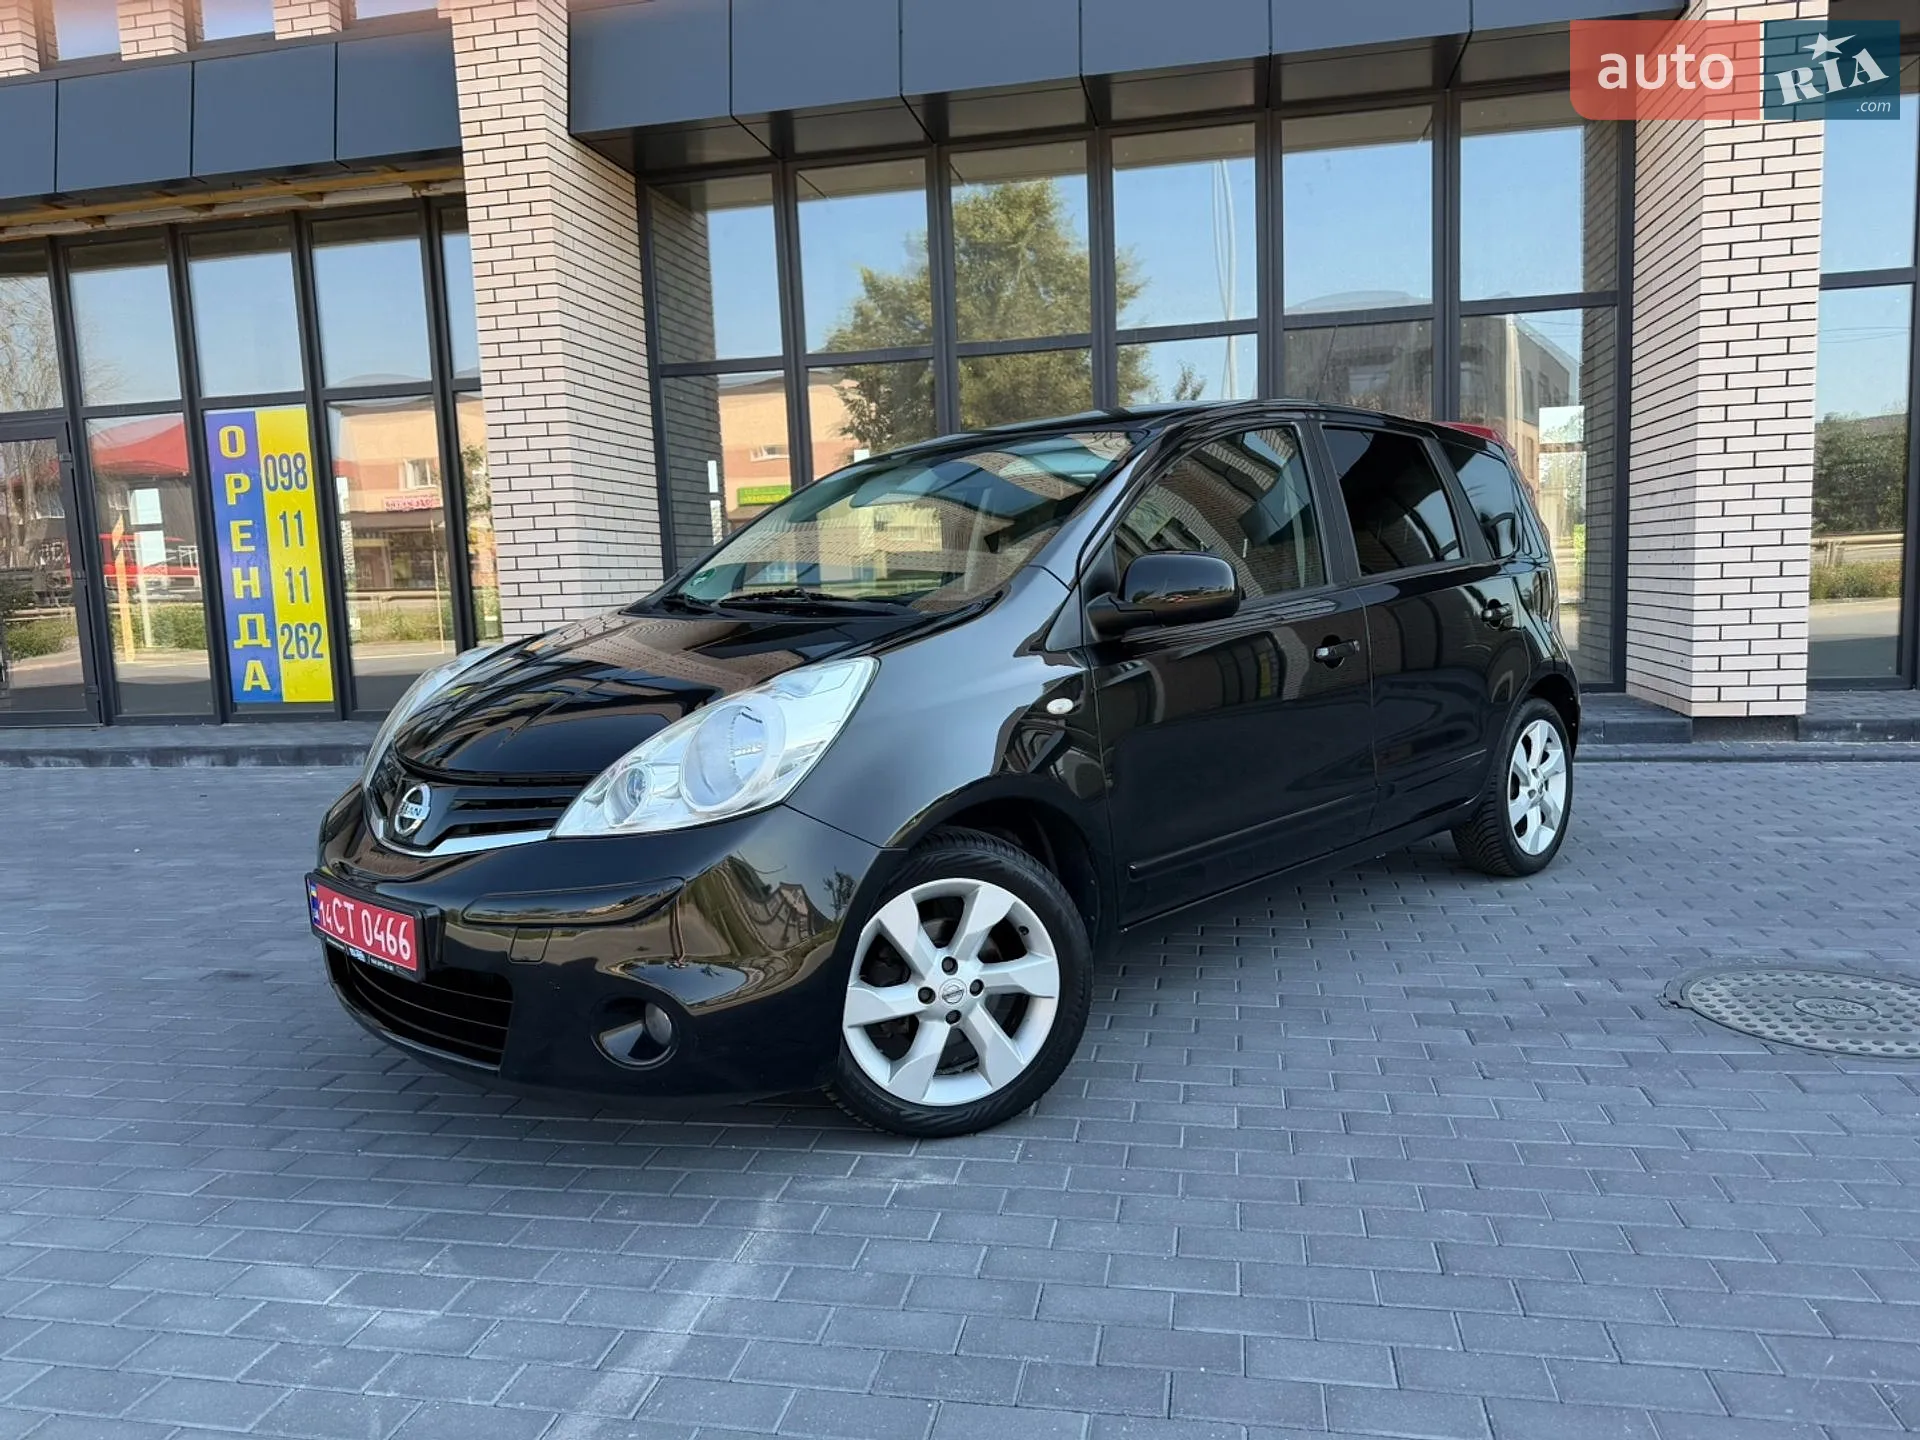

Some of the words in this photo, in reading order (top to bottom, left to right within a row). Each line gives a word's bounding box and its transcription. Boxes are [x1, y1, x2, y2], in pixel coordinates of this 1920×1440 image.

[263, 452, 309, 493] 098
[278, 509, 305, 548] 11
[218, 425, 272, 692] ОРЕНДА
[284, 566, 310, 604] 11
[280, 622, 324, 660] 262
[361, 908, 411, 961] 0466
